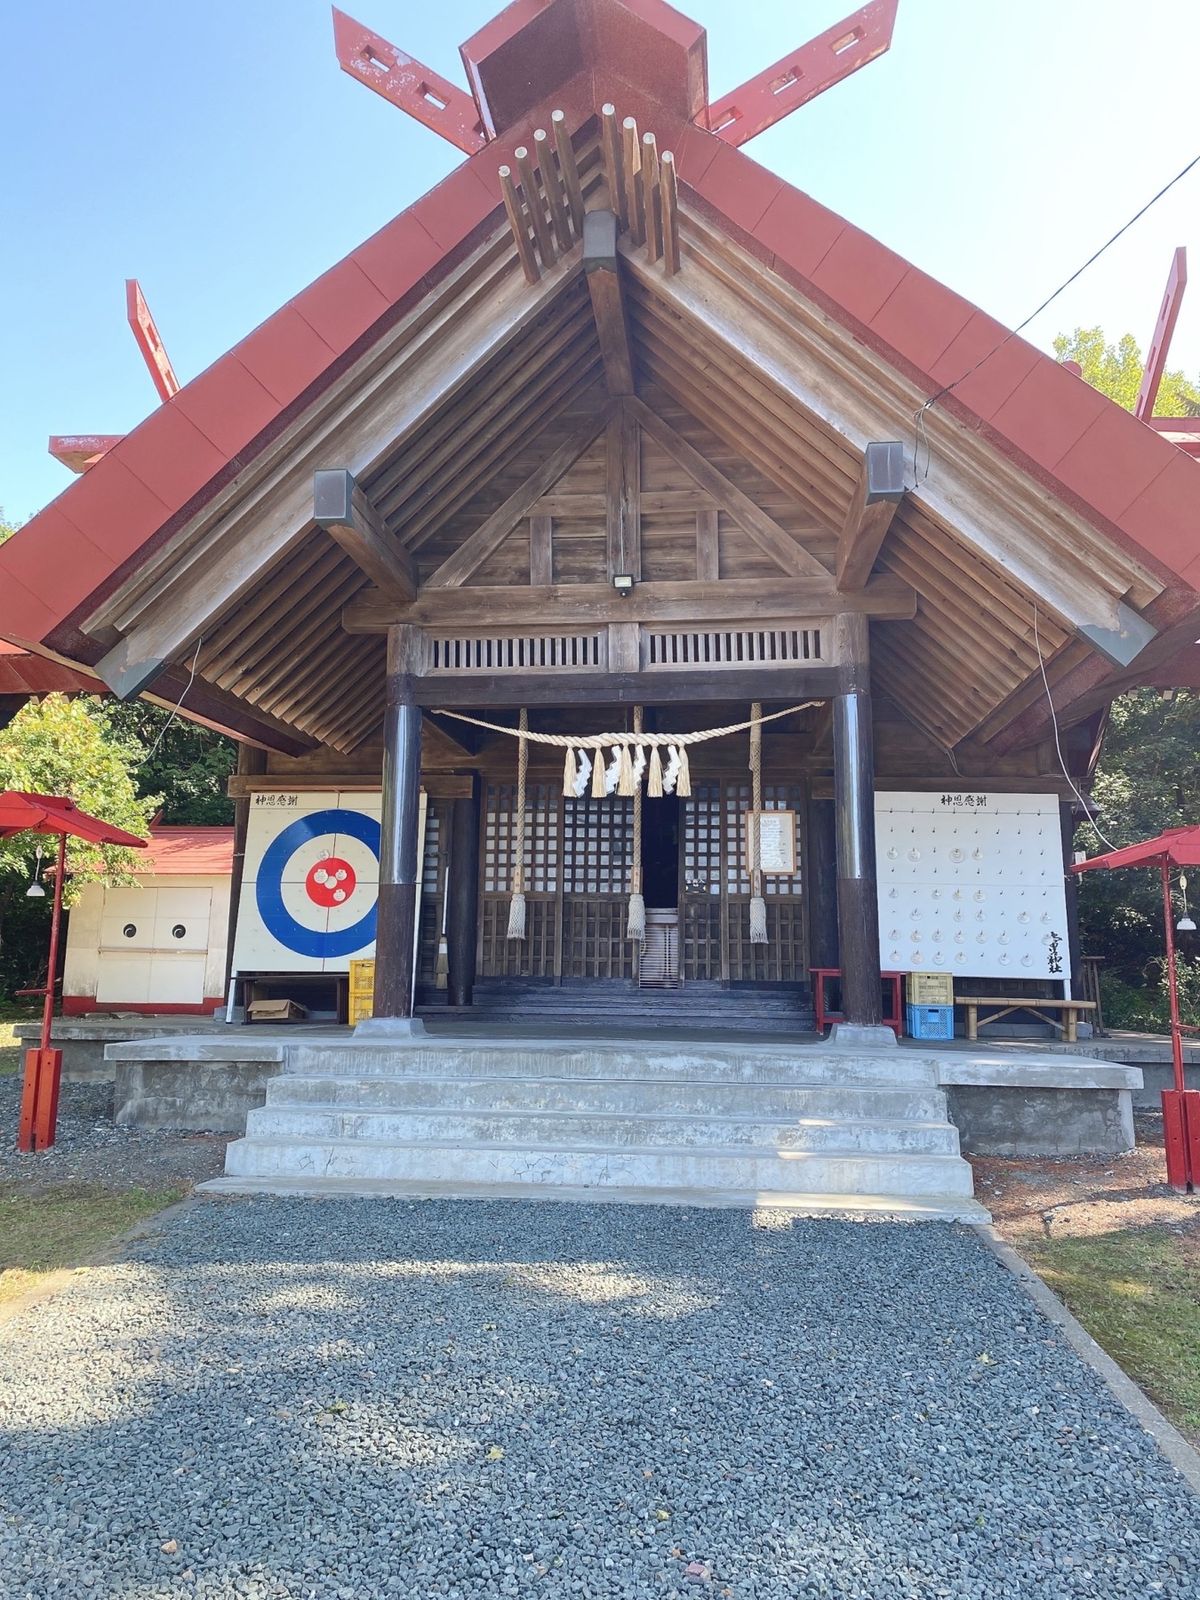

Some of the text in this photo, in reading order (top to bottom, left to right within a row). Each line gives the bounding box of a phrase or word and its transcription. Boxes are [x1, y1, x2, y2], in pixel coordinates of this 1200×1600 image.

[255, 794, 298, 807] 神恩感謝
[940, 794, 987, 807] 神恩感謝
